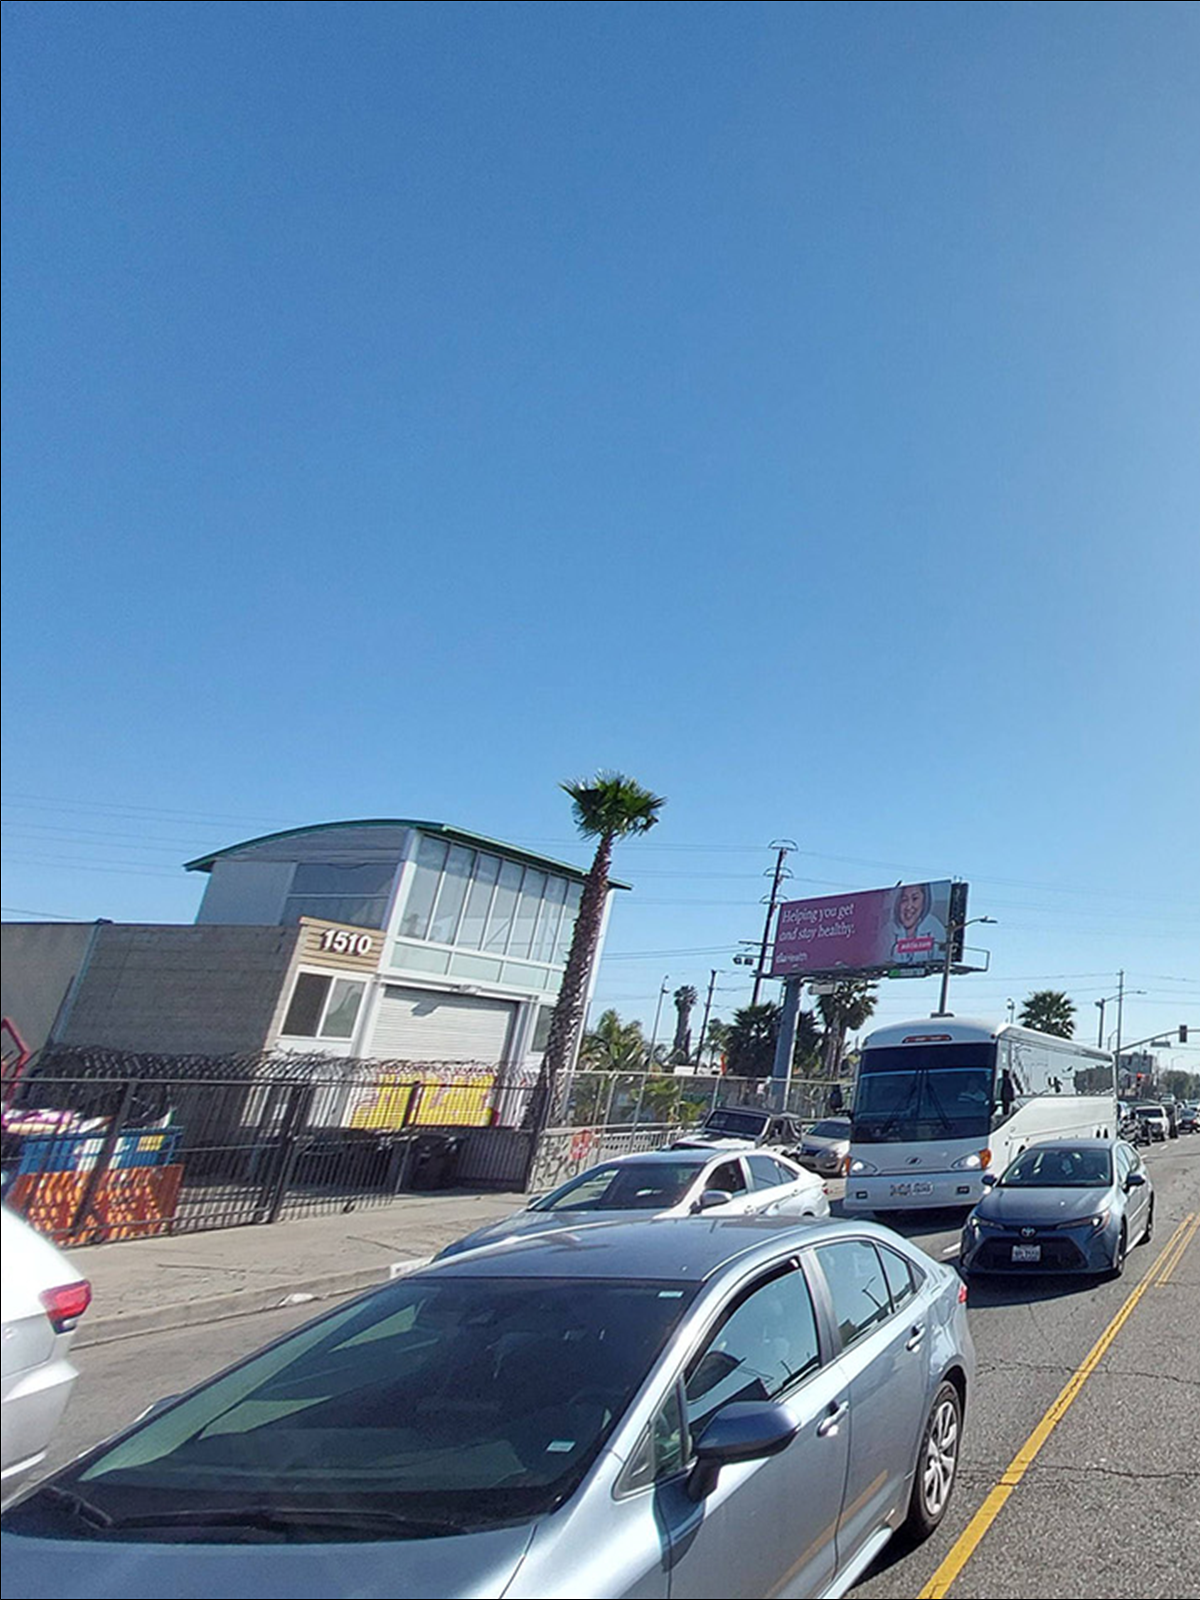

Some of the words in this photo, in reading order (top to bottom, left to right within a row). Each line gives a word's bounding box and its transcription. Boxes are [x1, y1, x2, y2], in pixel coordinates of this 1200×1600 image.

[781, 906, 818, 924] Helping
[818, 906, 837, 922] you
[837, 903, 855, 920] get
[322, 928, 373, 955] 1510
[779, 927, 798, 942] and
[798, 926, 817, 942] stay
